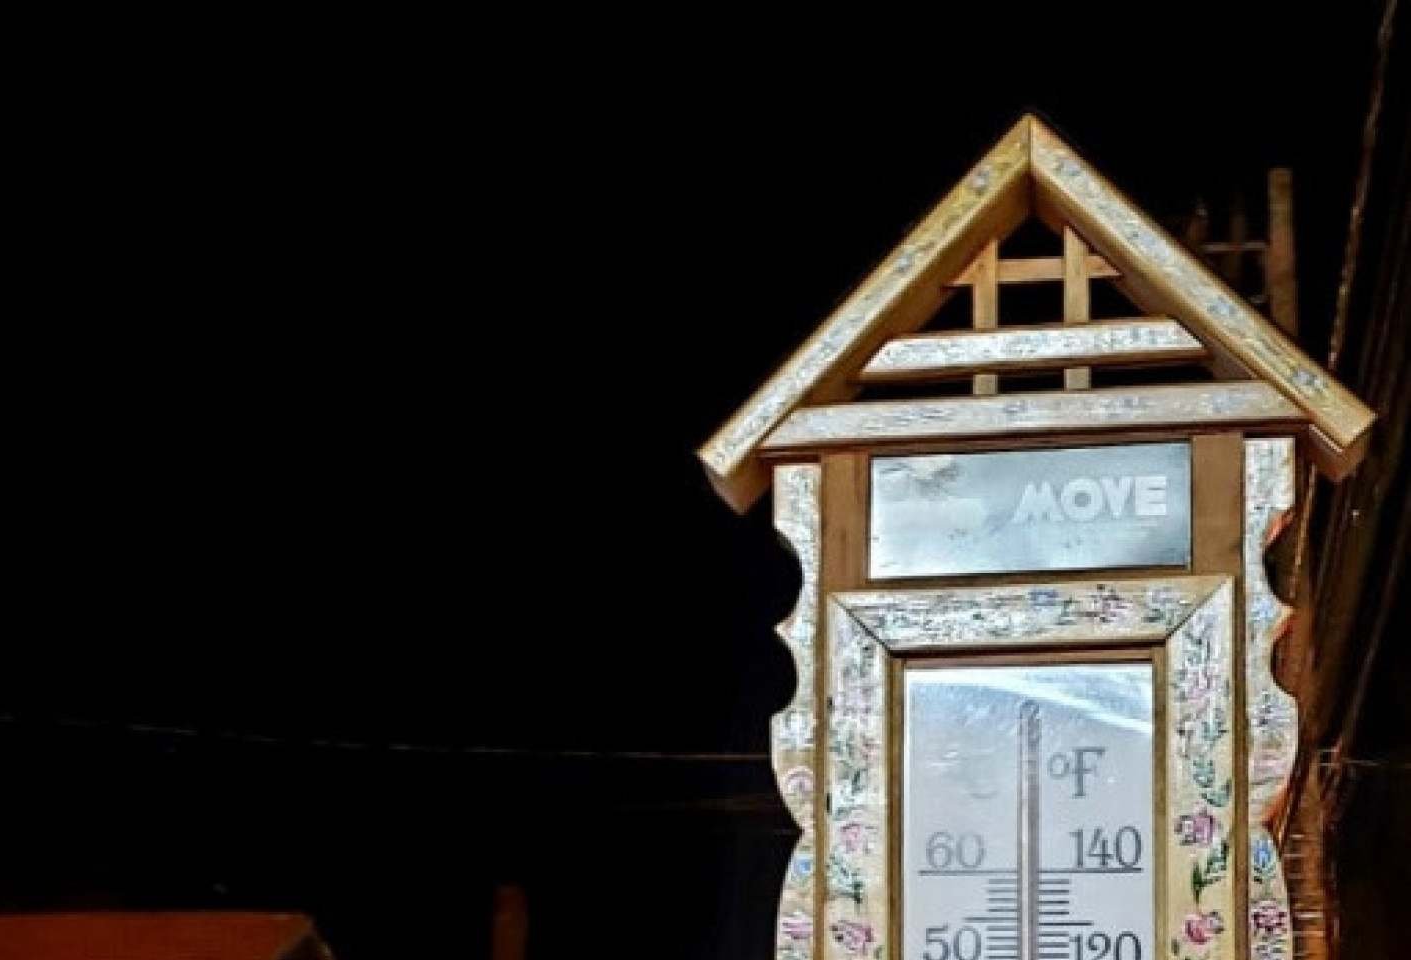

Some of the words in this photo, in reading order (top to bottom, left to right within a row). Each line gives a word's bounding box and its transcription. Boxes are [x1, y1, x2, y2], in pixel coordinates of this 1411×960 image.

[1013, 475, 1166, 524] MOVE
[925, 830, 986, 869] 60
[1068, 825, 1142, 868] 140
